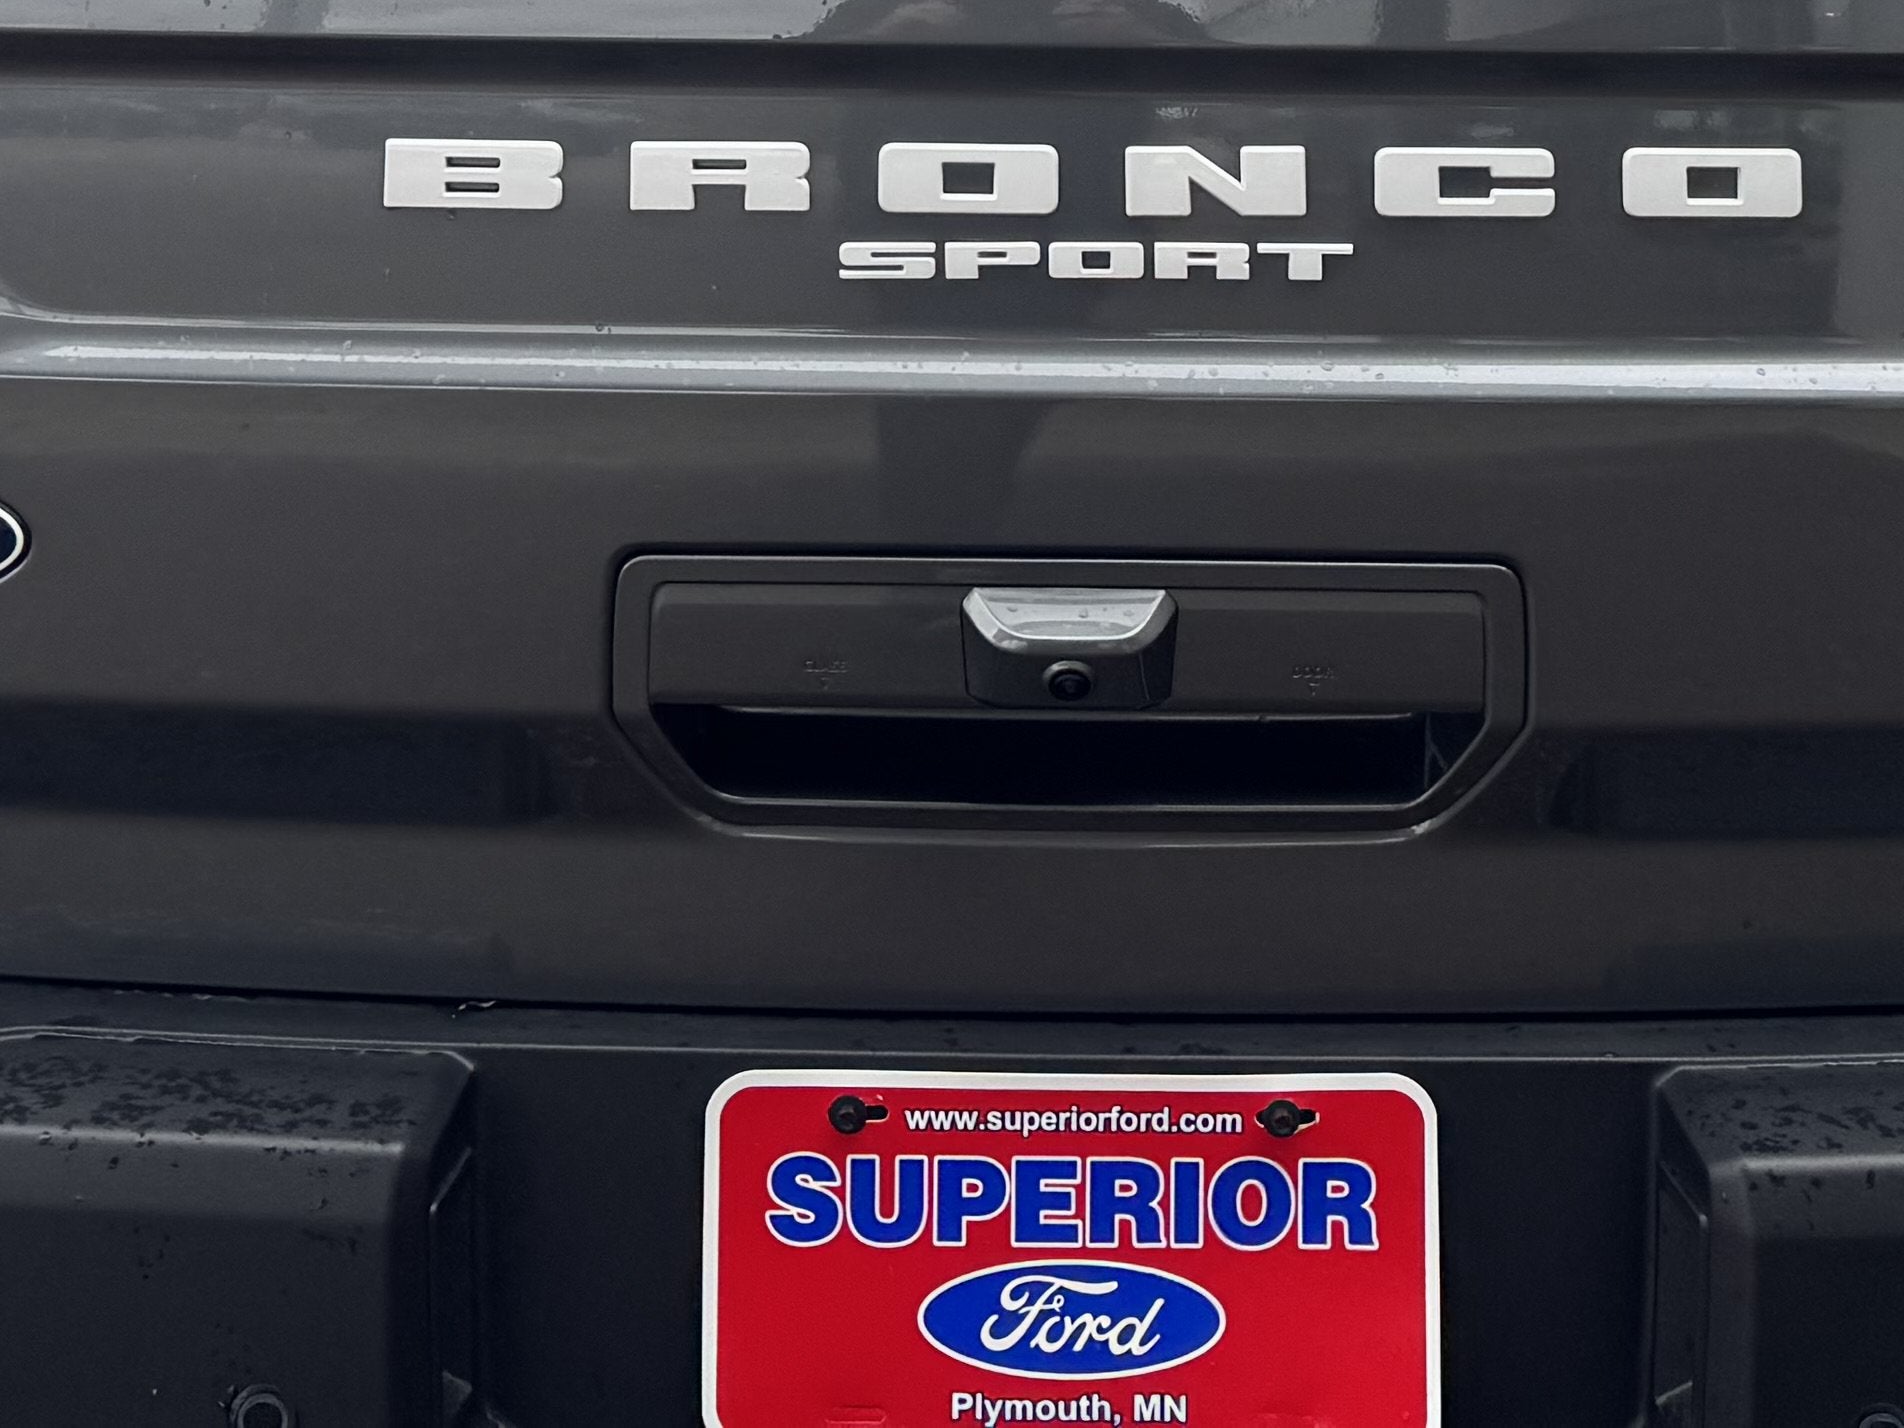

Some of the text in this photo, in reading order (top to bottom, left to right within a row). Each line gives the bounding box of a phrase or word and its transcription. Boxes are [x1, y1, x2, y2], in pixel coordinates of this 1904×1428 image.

[383, 137, 1803, 218] BRONCO
[838, 241, 1354, 281] SPORT
[904, 1105, 1243, 1138] www.superiorford.com
[764, 1152, 1380, 1251] SUPERIOR
[980, 1274, 1167, 1357] Ford
[951, 1392, 1187, 1428] Plymouth, MN
